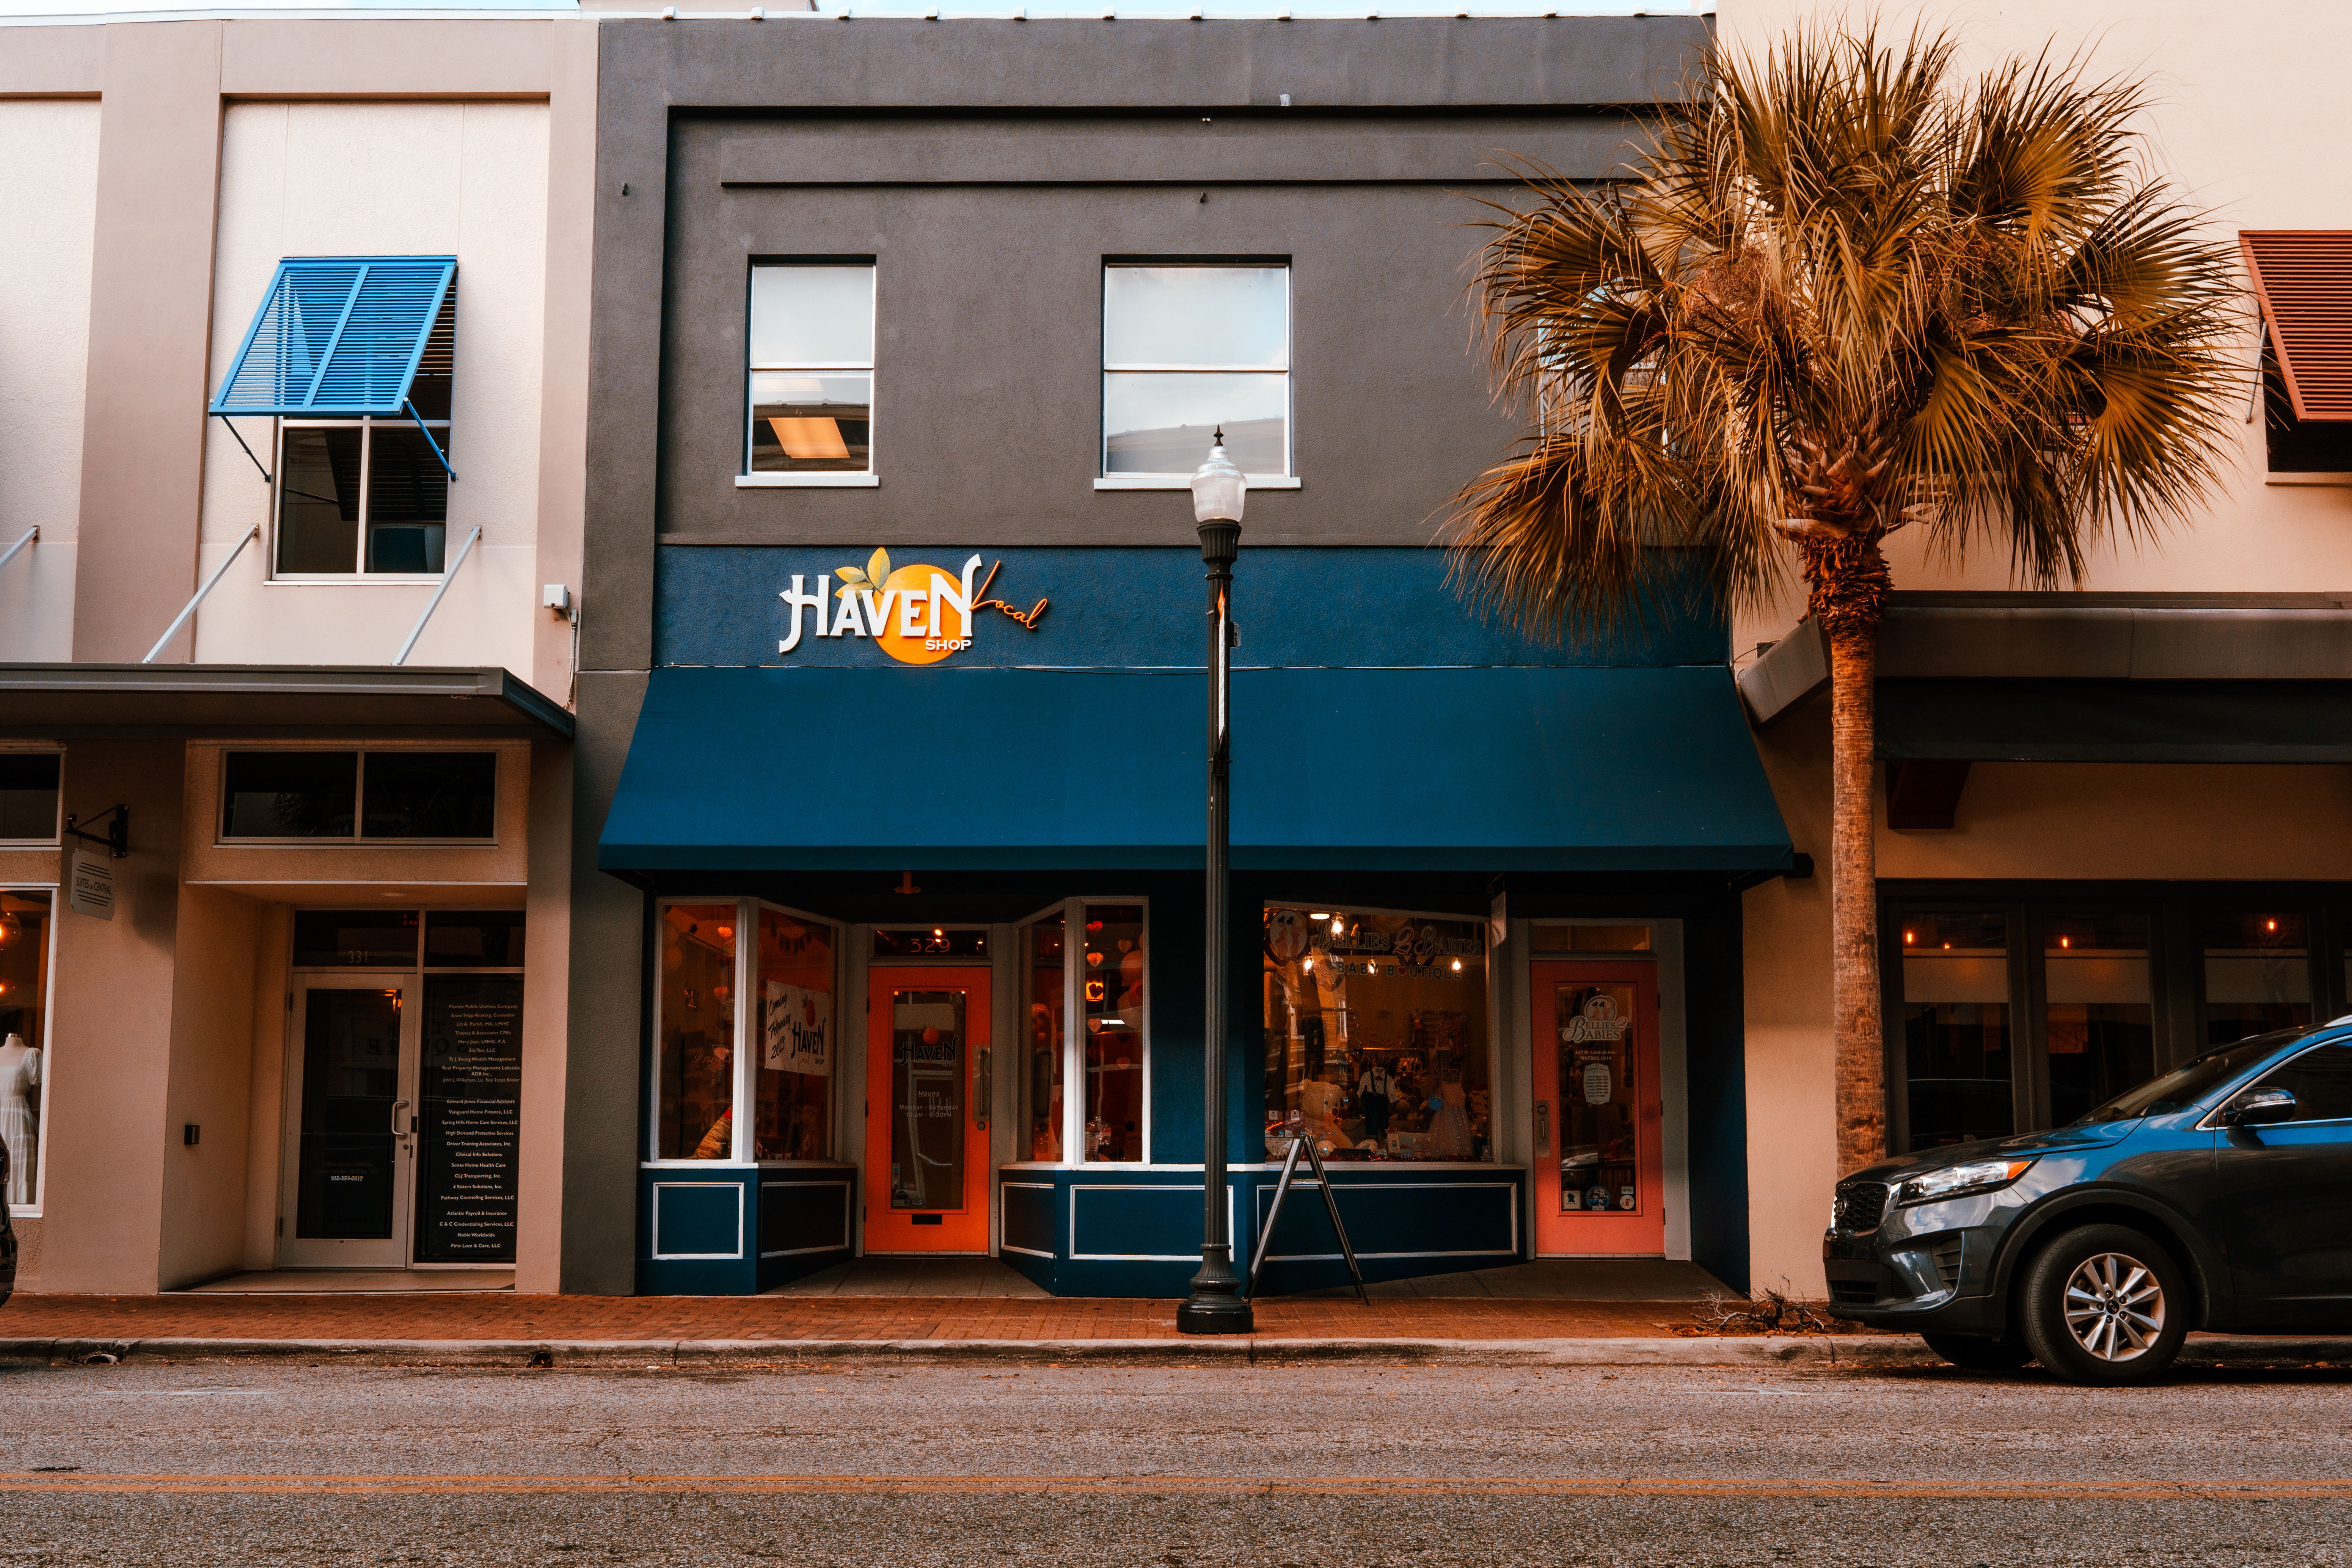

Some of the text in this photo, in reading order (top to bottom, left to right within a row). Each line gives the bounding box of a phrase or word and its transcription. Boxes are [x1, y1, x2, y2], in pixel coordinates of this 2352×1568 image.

[779, 554, 982, 653] HAVEN
[925, 639, 972, 651] SHOP
[76, 877, 89, 888] SUITES
[94, 882, 111, 895] CENTRAL
[910, 938, 950, 952] 329
[1309, 918, 1390, 952] BELLIES
[1415, 925, 1482, 957] BABIES
[349, 951, 367, 964] 331
[1336, 961, 1379, 976] BABY
[769, 992, 787, 1016] Coming
[768, 1013, 791, 1039] February
[771, 1036, 785, 1059] 2023
[791, 1017, 826, 1059] HAVEN
[900, 1035, 959, 1066] HAVEN
[2109, 1302, 2117, 1313] KIA
